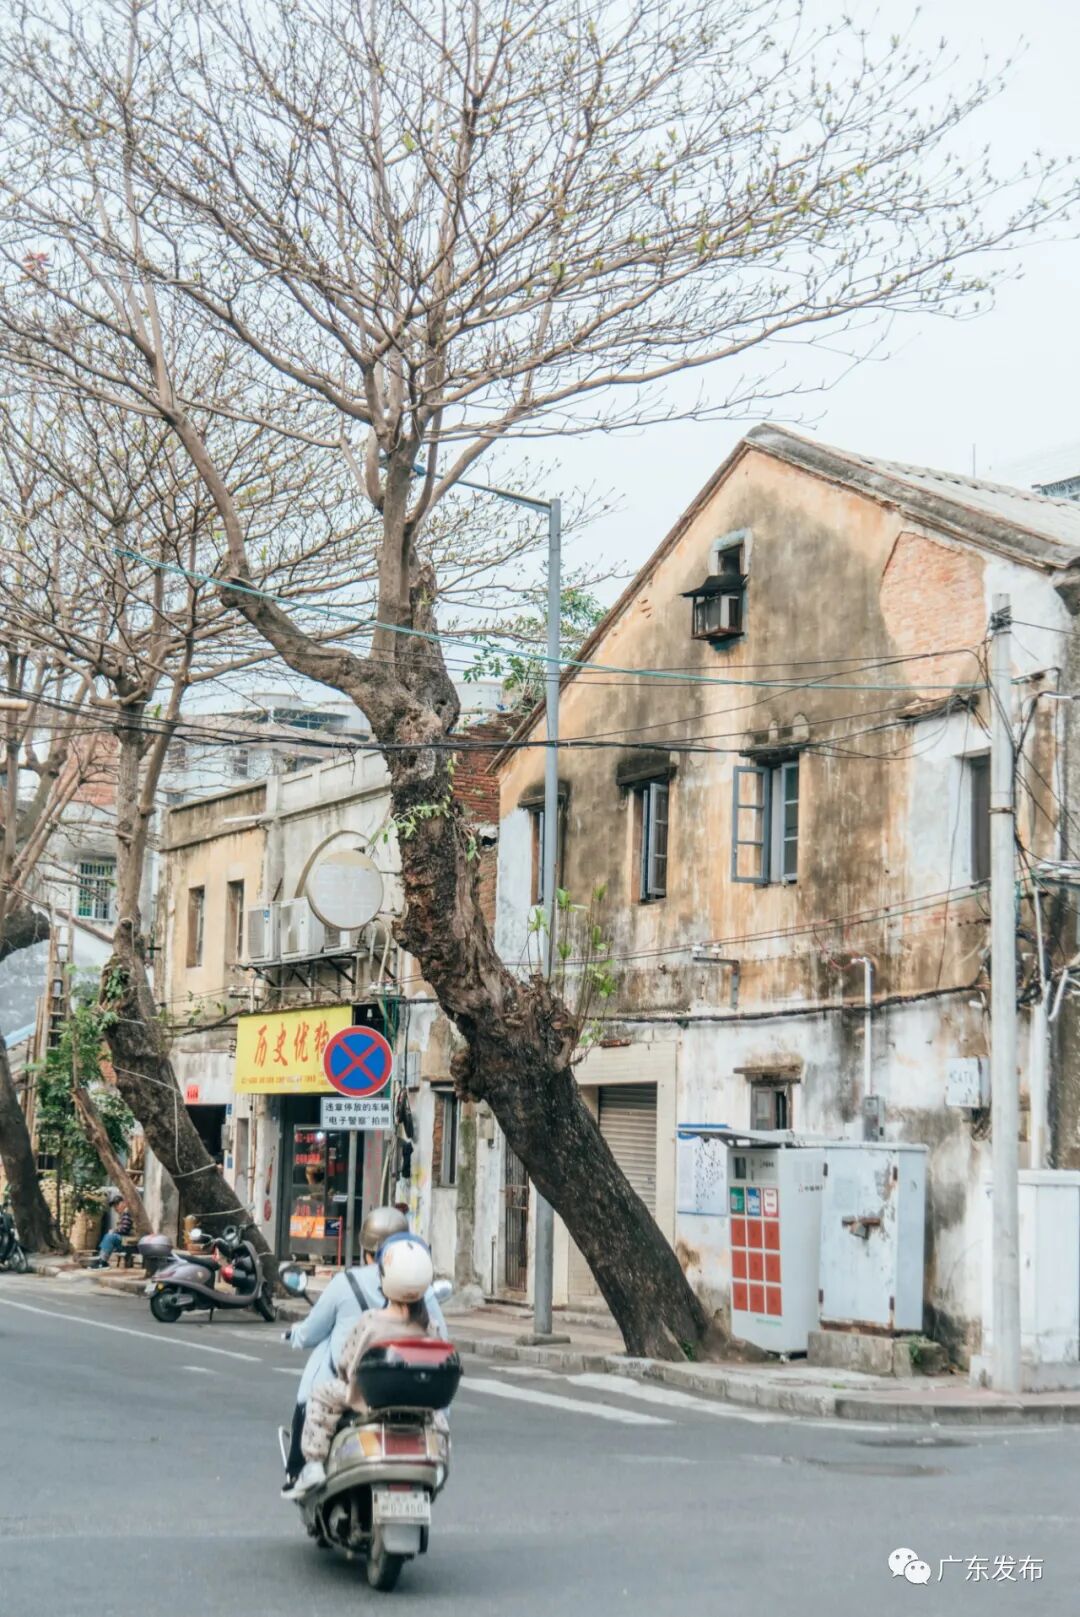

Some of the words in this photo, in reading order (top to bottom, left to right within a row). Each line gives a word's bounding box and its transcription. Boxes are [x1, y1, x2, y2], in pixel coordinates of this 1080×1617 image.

[325, 1102, 390, 1112] 违章停放的车辆
